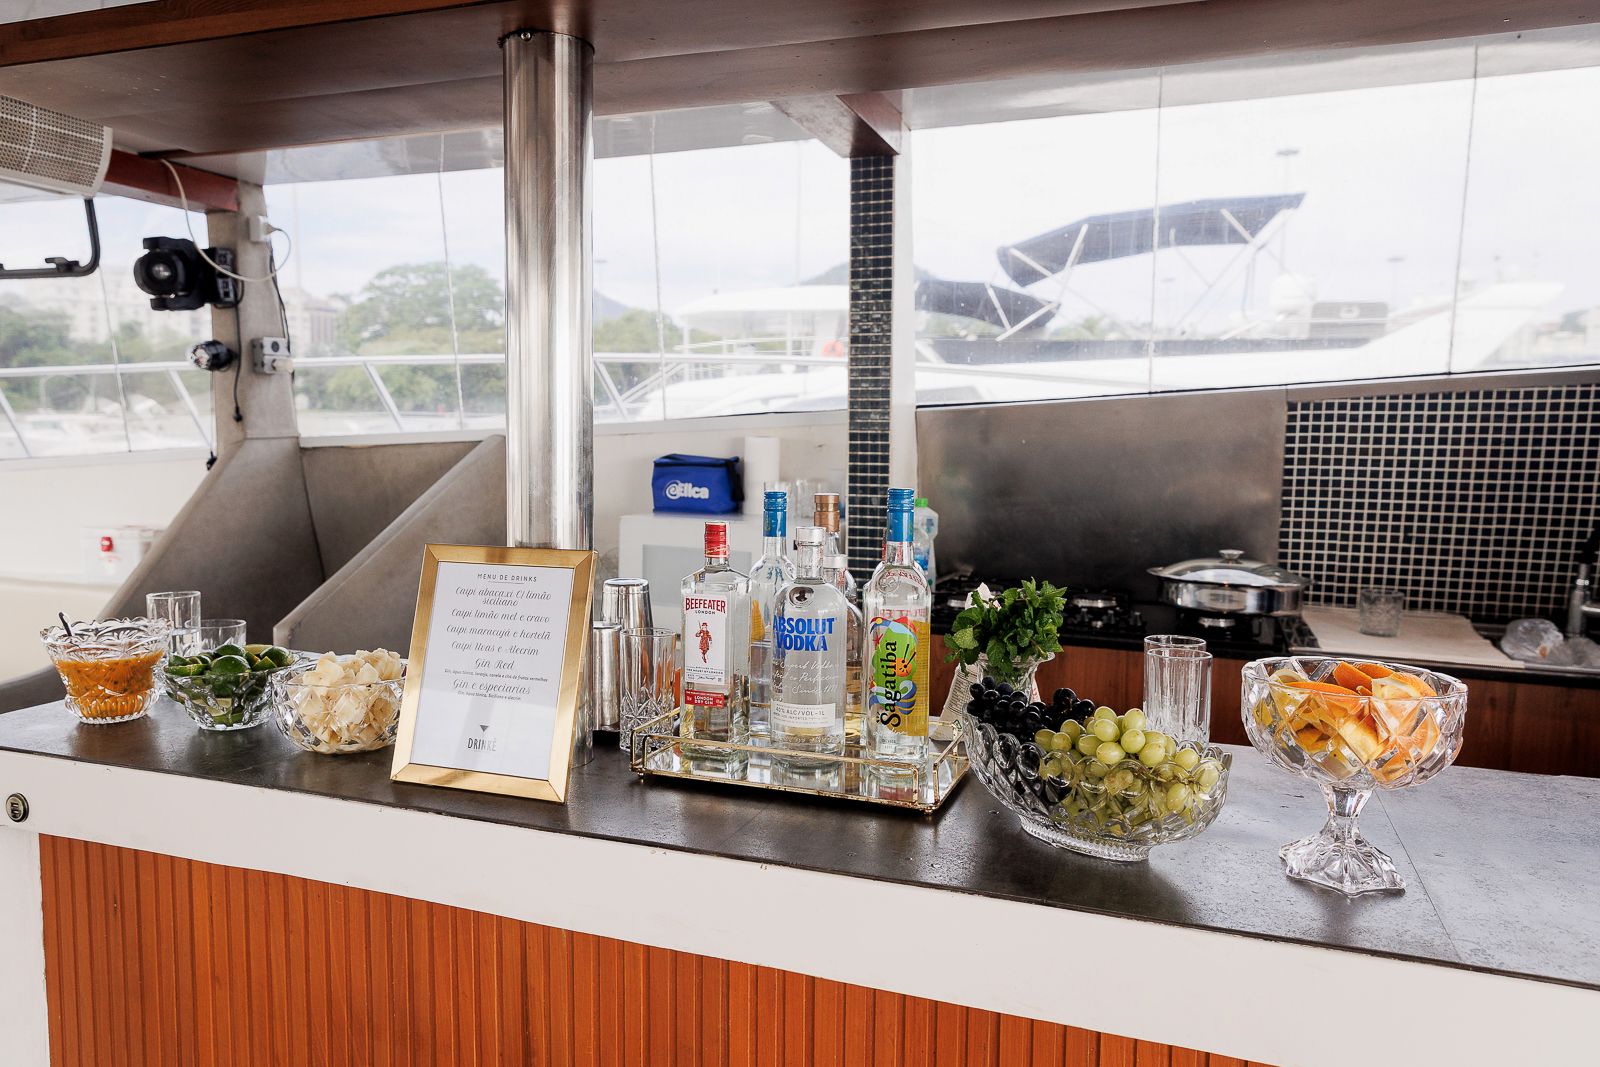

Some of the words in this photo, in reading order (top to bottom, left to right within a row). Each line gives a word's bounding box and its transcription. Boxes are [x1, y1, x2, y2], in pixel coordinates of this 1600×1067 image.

[455, 586, 476, 597] Caipi
[478, 588, 513, 598] abacaxi
[526, 590, 552, 600] limão
[482, 597, 519, 606] siciliano
[685, 597, 726, 614] BEEFEATER
[451, 608, 472, 619] Caipi
[474, 610, 500, 619] limão
[500, 612, 518, 620] mel
[519, 614, 524, 622] e
[526, 616, 550, 624] cravo
[446, 624, 467, 635] Caipi
[469, 628, 511, 639] maracujá
[520, 629, 551, 640] hortelã
[773, 615, 835, 634] ABSOLUT
[452, 640, 472, 652] Caipi
[474, 642, 495, 652] Uvas
[506, 645, 539, 656] Alecrim
[776, 632, 828, 651] VODKA
[475, 658, 490, 668] Gin
[495, 660, 515, 670] Red
[454, 678, 469, 689] Gin
[472, 682, 478, 690] e
[479, 682, 530, 694] especiarias
[880, 640, 902, 727] Sagatiba
